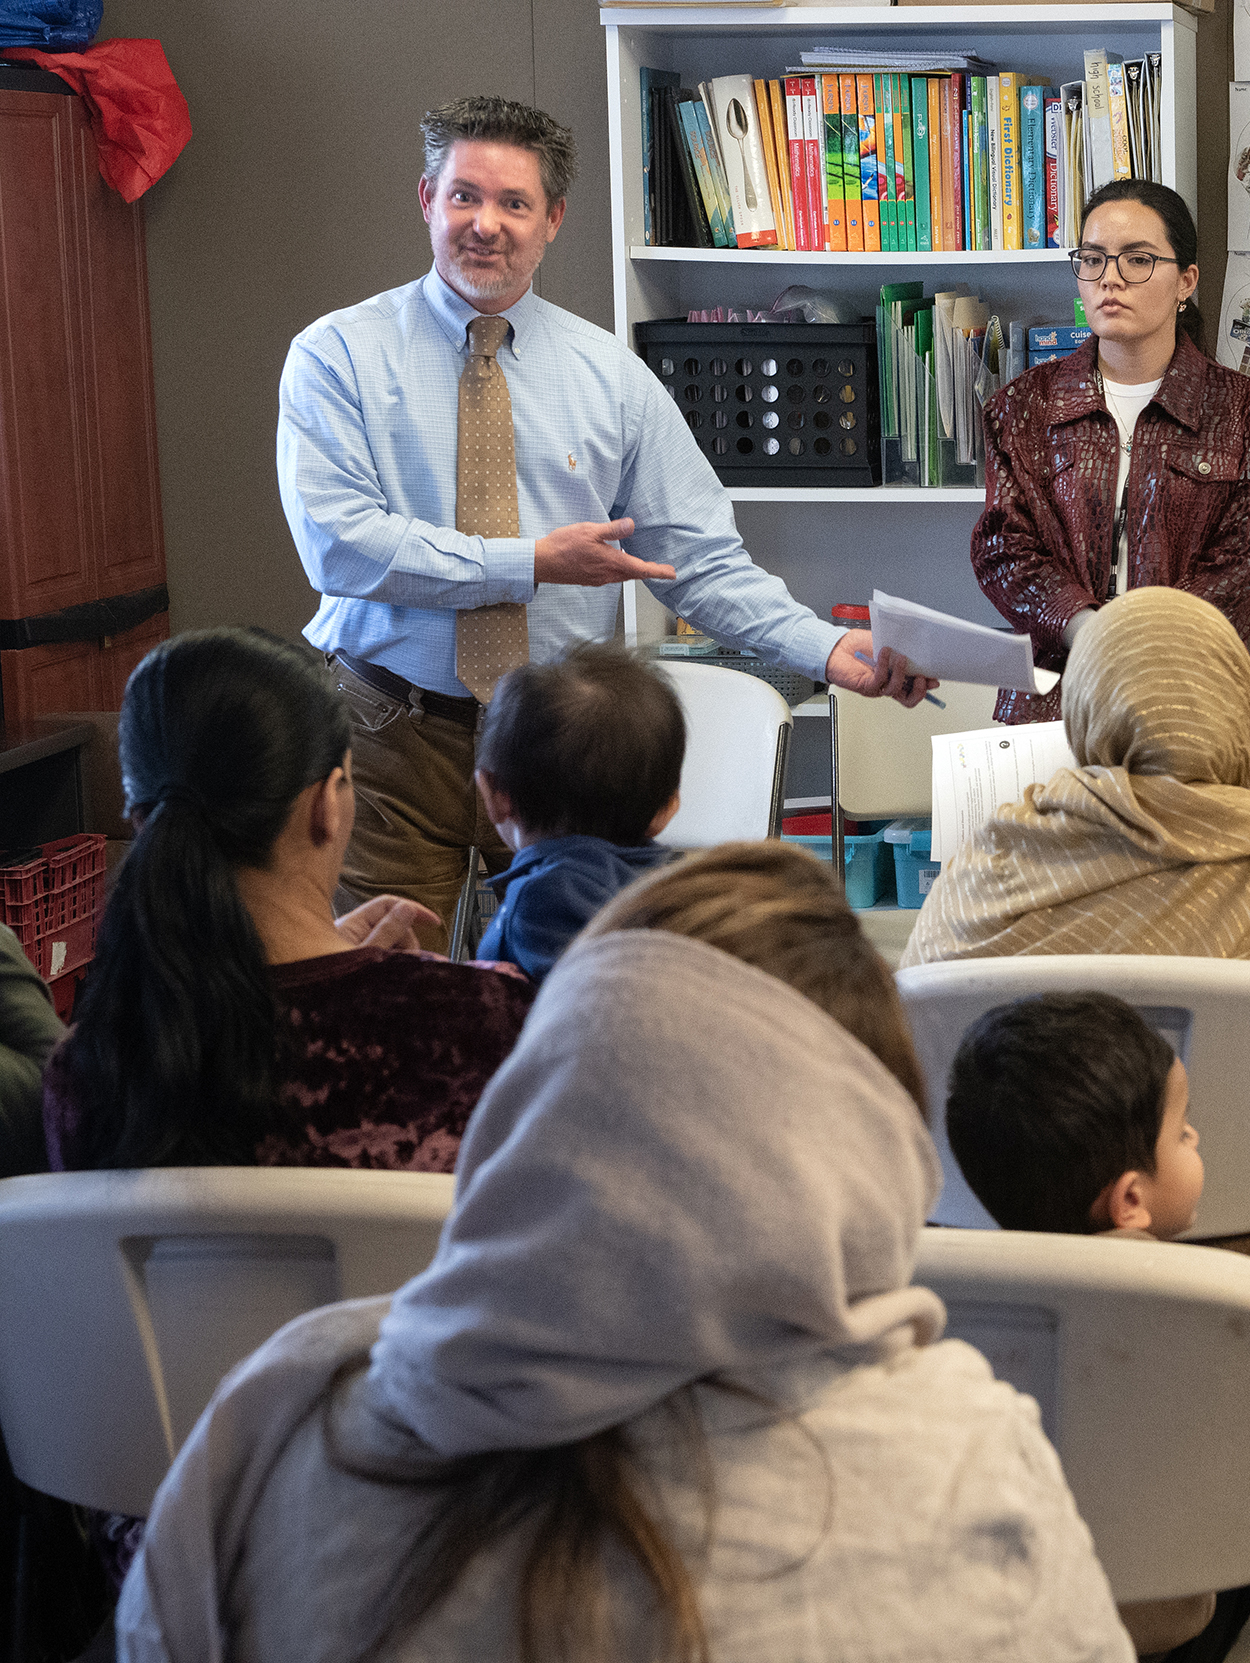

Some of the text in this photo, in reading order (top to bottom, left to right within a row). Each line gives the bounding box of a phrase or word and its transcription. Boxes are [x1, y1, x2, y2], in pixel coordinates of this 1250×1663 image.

[1089, 62, 1104, 110] high school
[793, 143, 802, 177] Mathematics
[808, 143, 816, 177] Mathematics
[1003, 117, 1013, 206] First Dictionary
[1026, 118, 1038, 221] Elementary Dictionary
[1046, 162, 1057, 212] Dictionary
